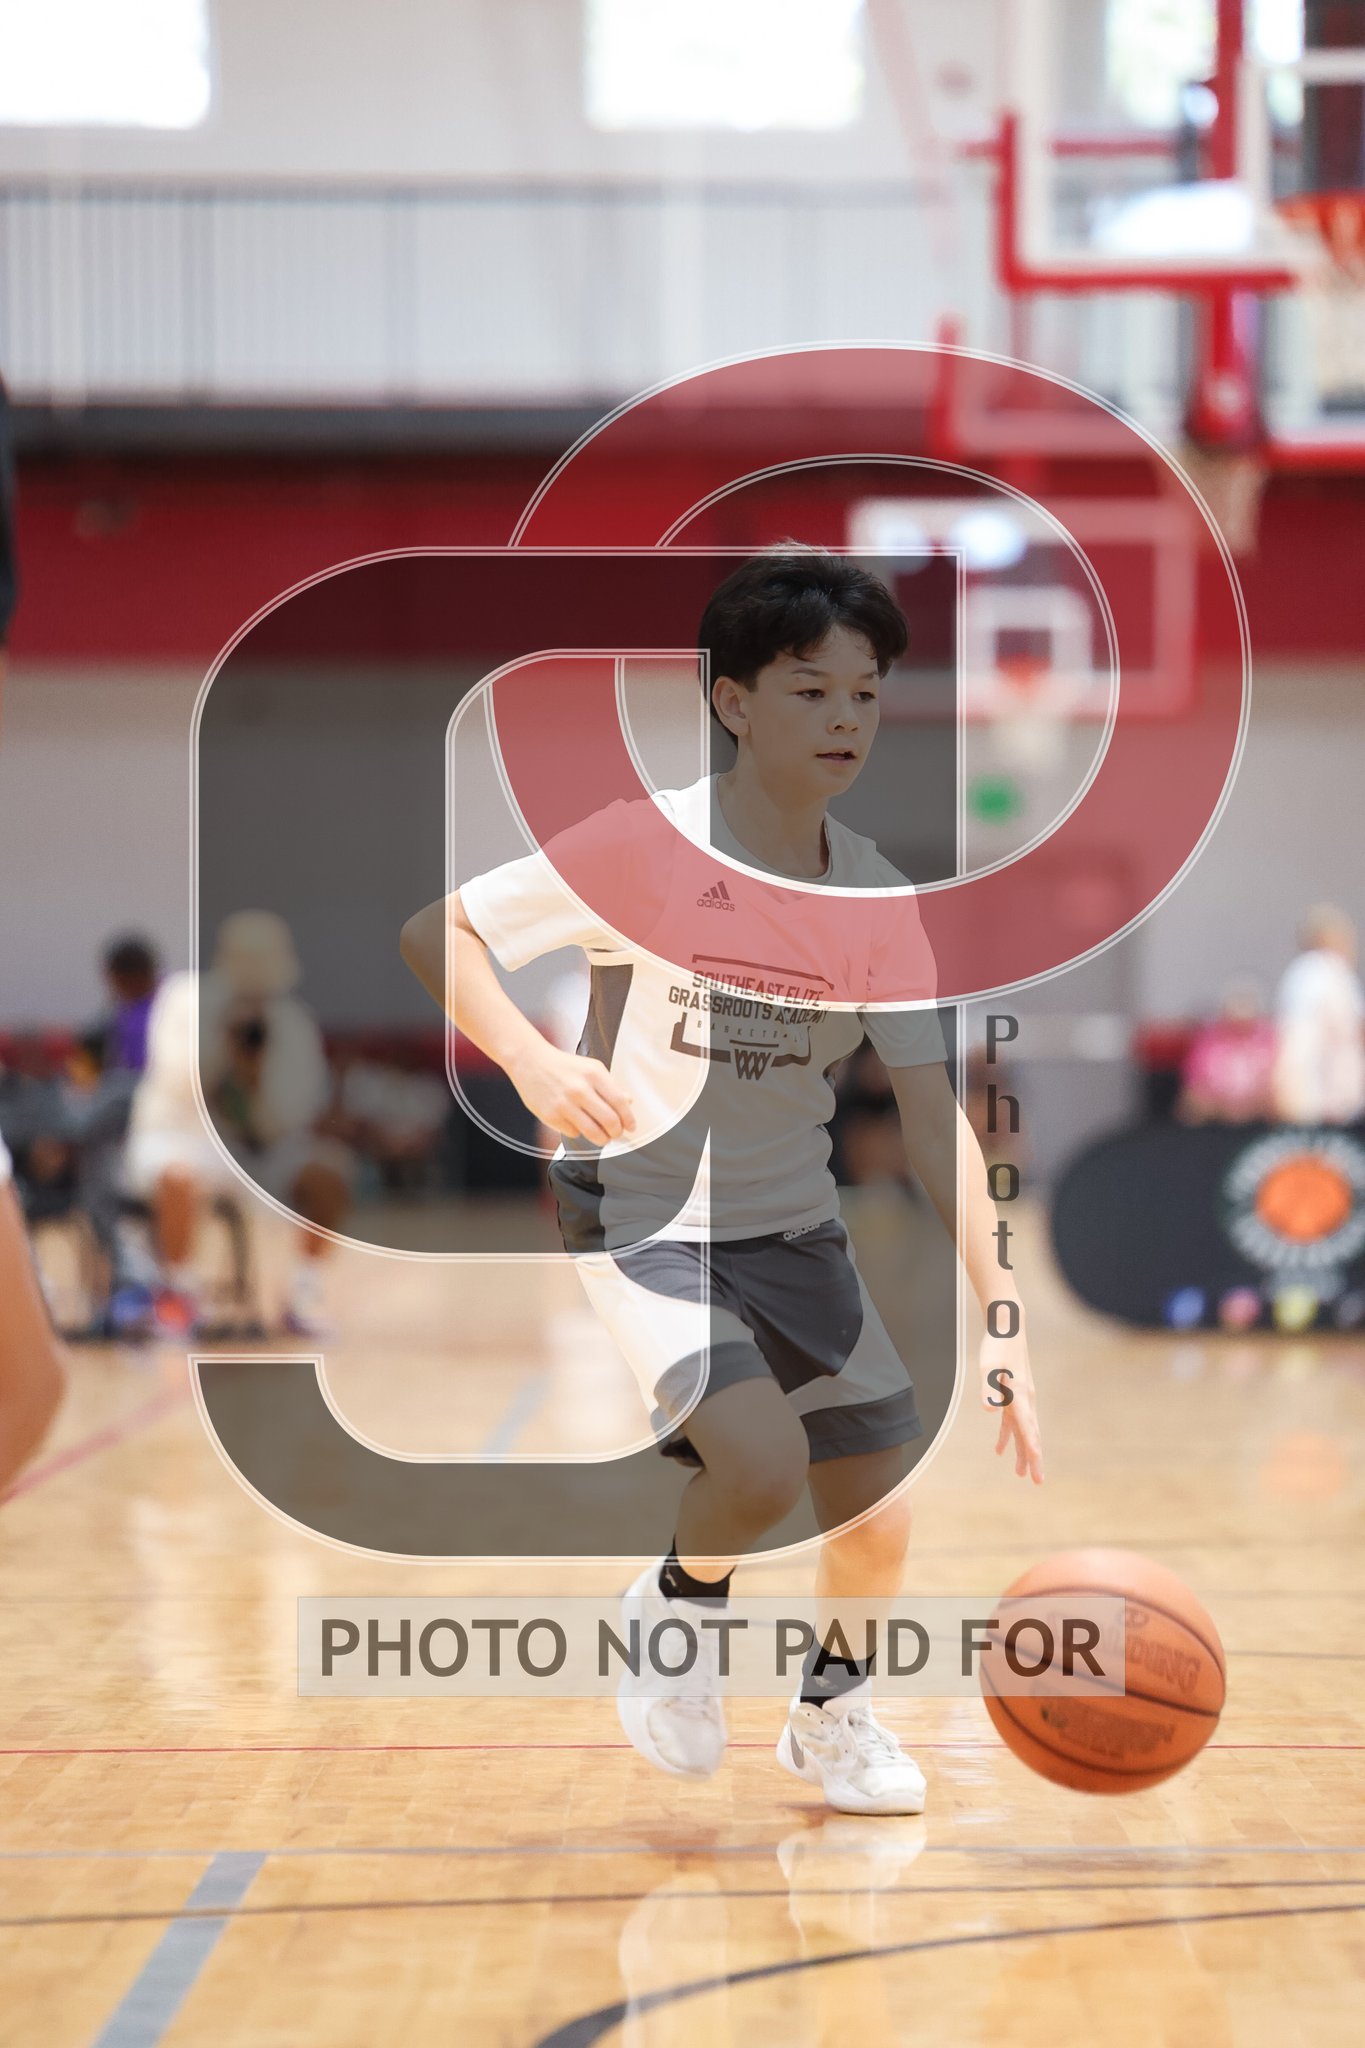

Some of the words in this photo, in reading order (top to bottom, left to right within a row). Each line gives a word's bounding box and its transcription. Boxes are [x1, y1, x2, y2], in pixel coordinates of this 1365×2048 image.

[696, 896, 736, 912] adidas
[668, 985, 773, 1020] GRASSROOTS
[692, 969, 785, 1001] SOUTHEAST
[784, 986, 824, 1007] ELITE
[697, 1019, 805, 1043] BASKETB
